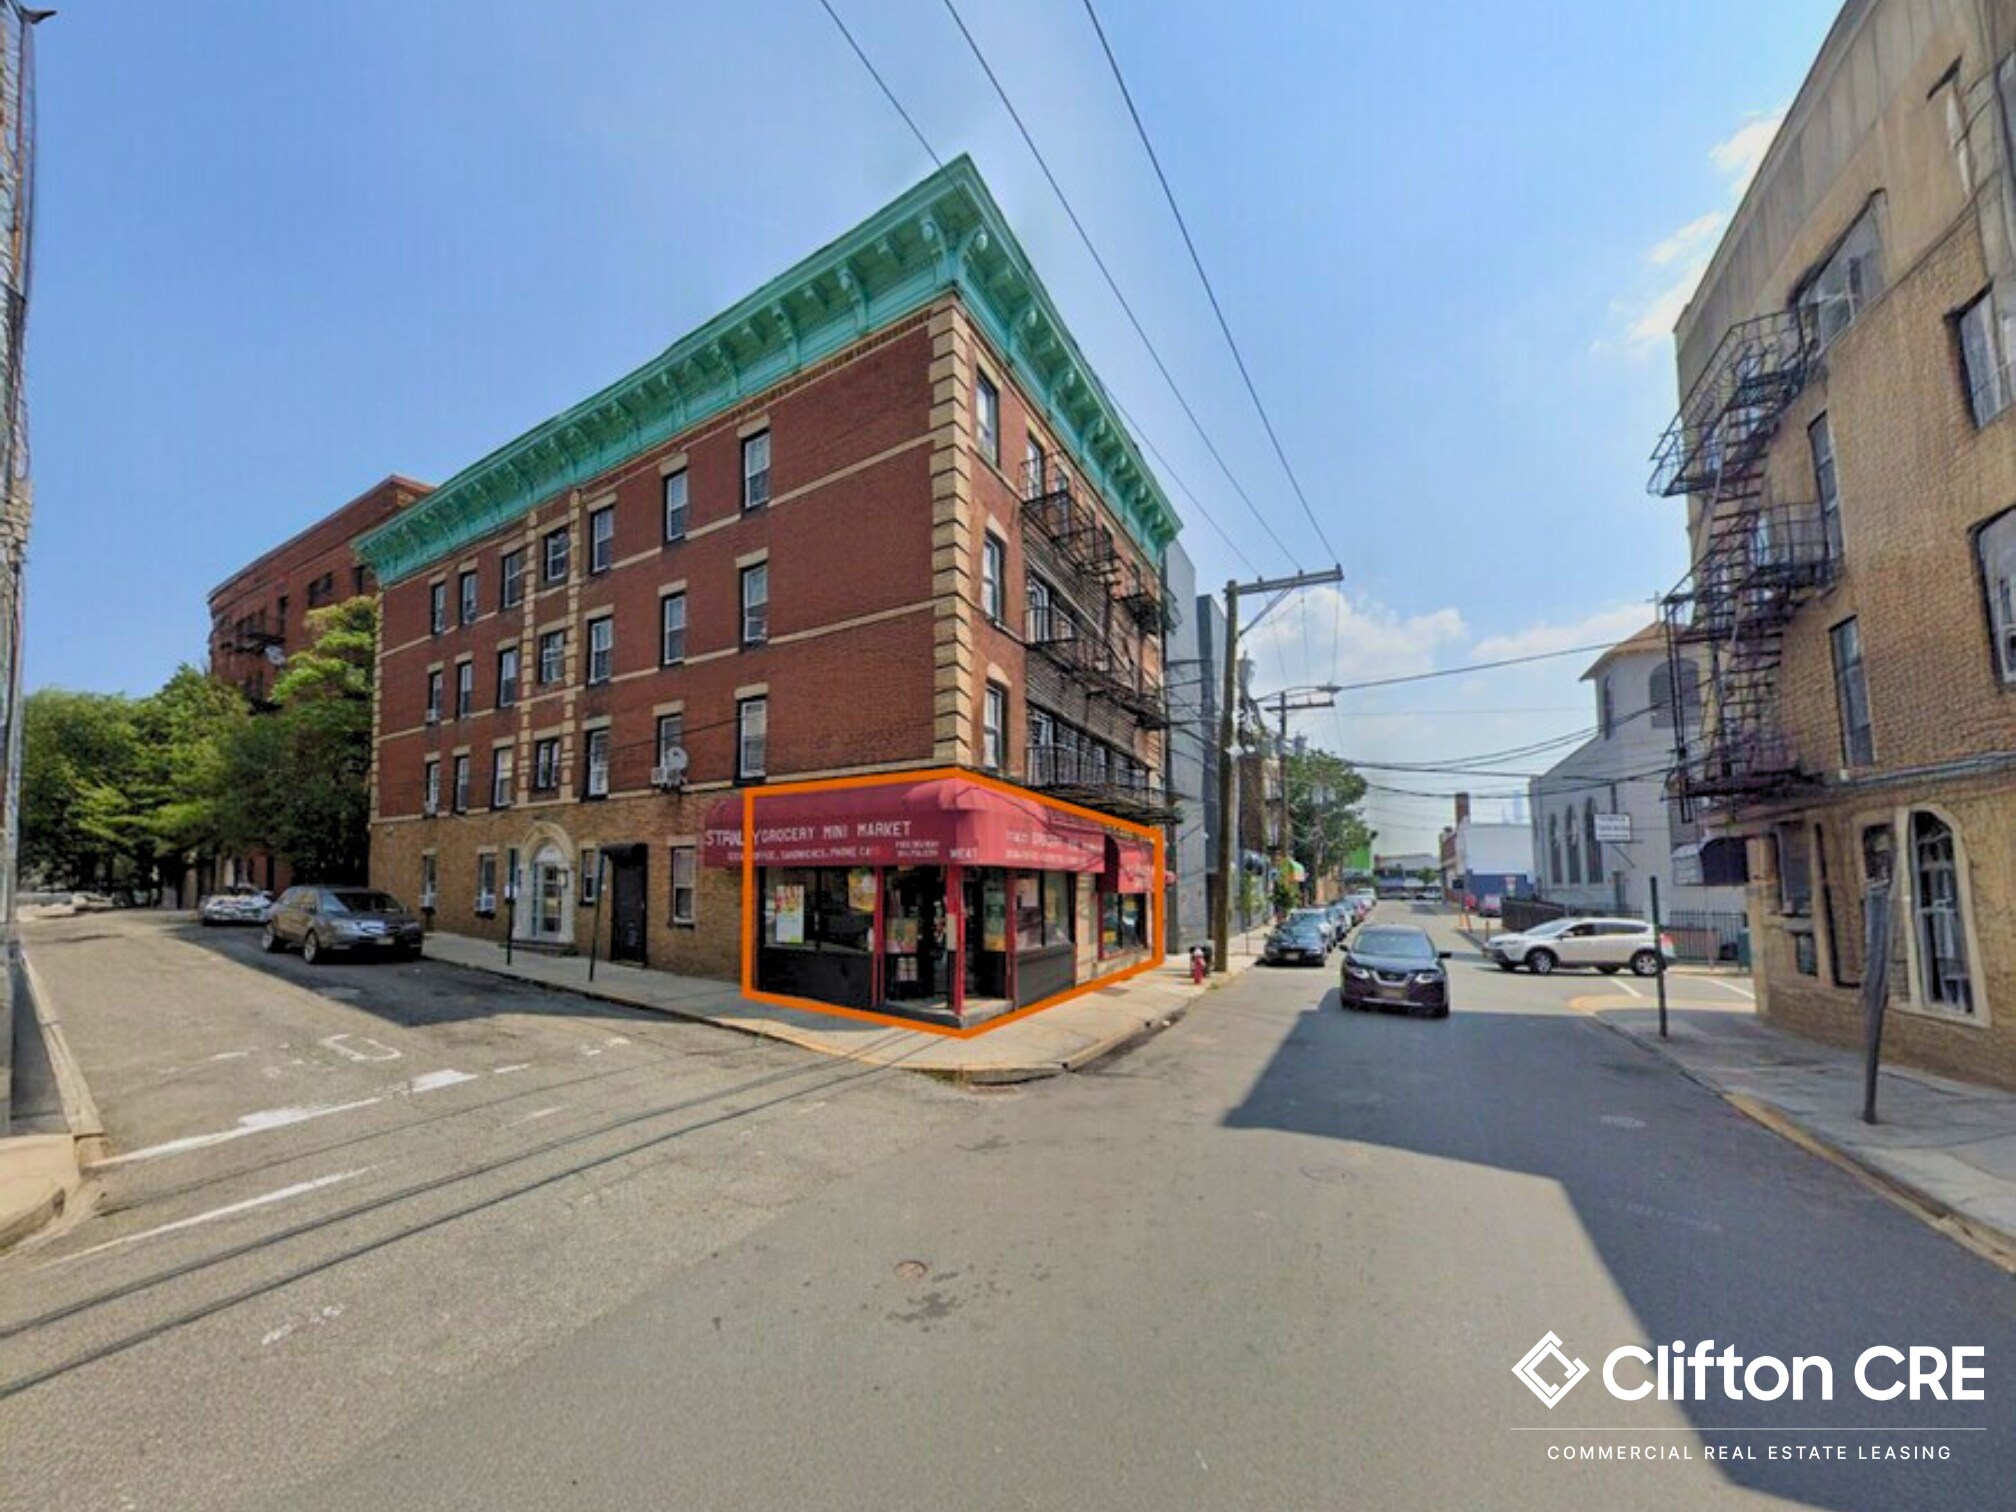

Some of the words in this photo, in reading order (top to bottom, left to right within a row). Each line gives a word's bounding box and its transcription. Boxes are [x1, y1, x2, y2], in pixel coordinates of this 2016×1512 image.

[704, 827, 761, 847] STANLY
[762, 826, 816, 843] GROCERY
[823, 825, 848, 841] MINI
[857, 820, 912, 838] MARKET
